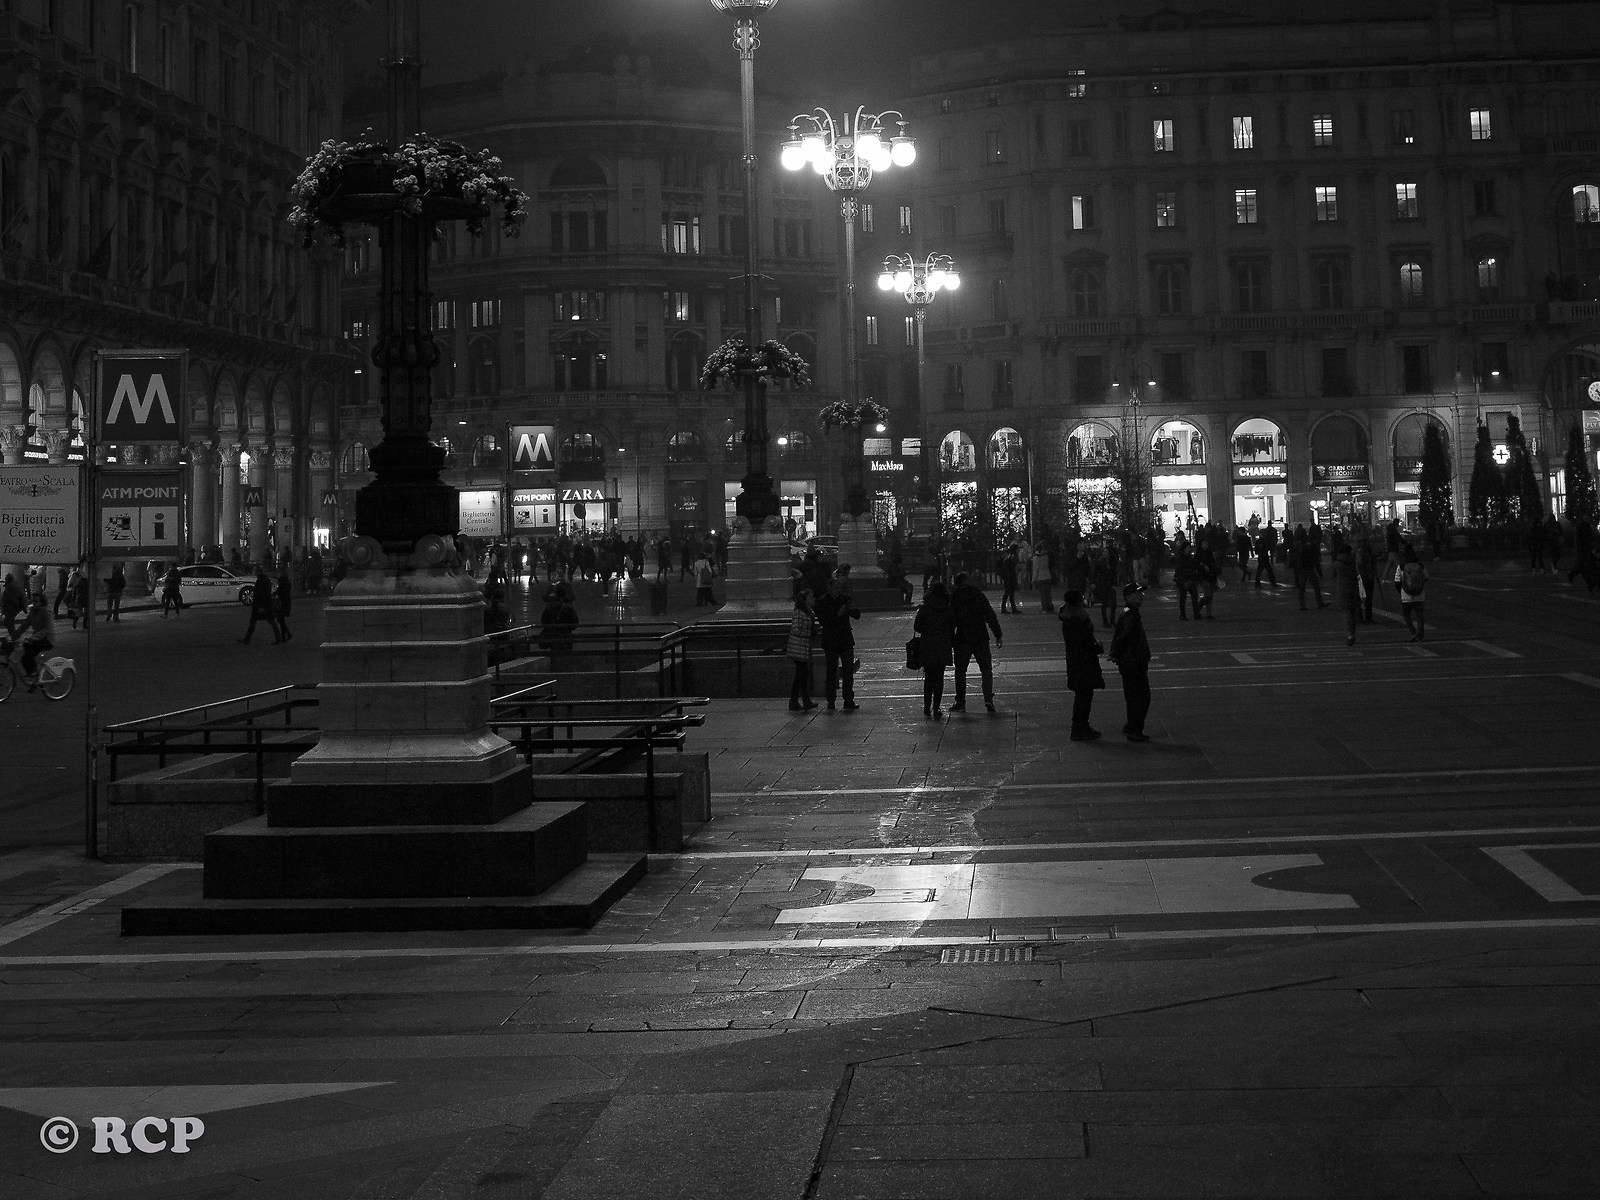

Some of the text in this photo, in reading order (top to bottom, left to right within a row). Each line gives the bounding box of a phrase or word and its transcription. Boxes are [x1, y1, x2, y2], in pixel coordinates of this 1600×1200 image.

[105, 373, 176, 424] M
[514, 433, 553, 462] M
[1238, 466, 1281, 477] CHANGE
[0, 475, 28, 486] EATRO
[102, 487, 179, 499] ATM POINT
[513, 493, 556, 502] ATM POINT
[562, 489, 604, 501] ZARA
[2, 513, 65, 526] Biglietteria
[9, 526, 57, 537] Centrale
[3, 544, 61, 556] Ticket Office
